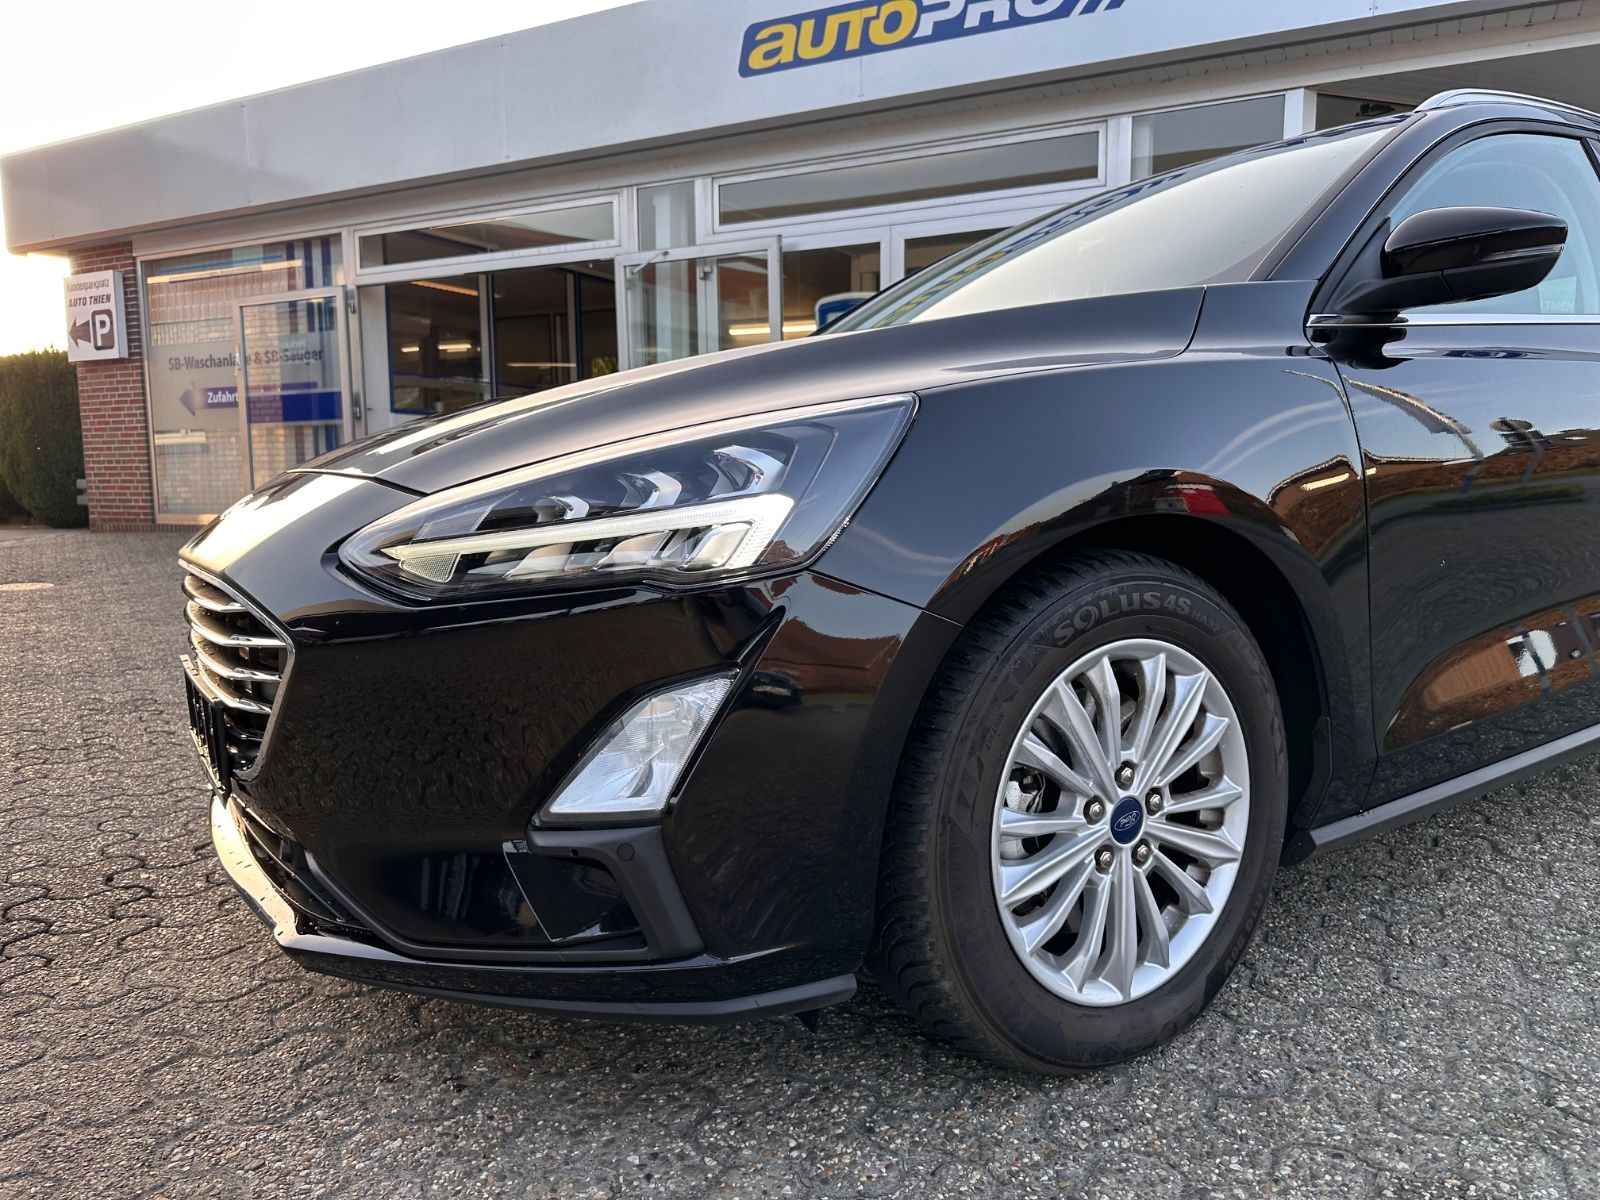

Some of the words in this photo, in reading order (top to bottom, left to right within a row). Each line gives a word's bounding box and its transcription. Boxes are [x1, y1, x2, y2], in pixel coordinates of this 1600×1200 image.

[69, 296, 87, 307] AUTO
[89, 294, 111, 305] THIEN
[95, 313, 111, 346] P
[254, 351, 262, 365] &
